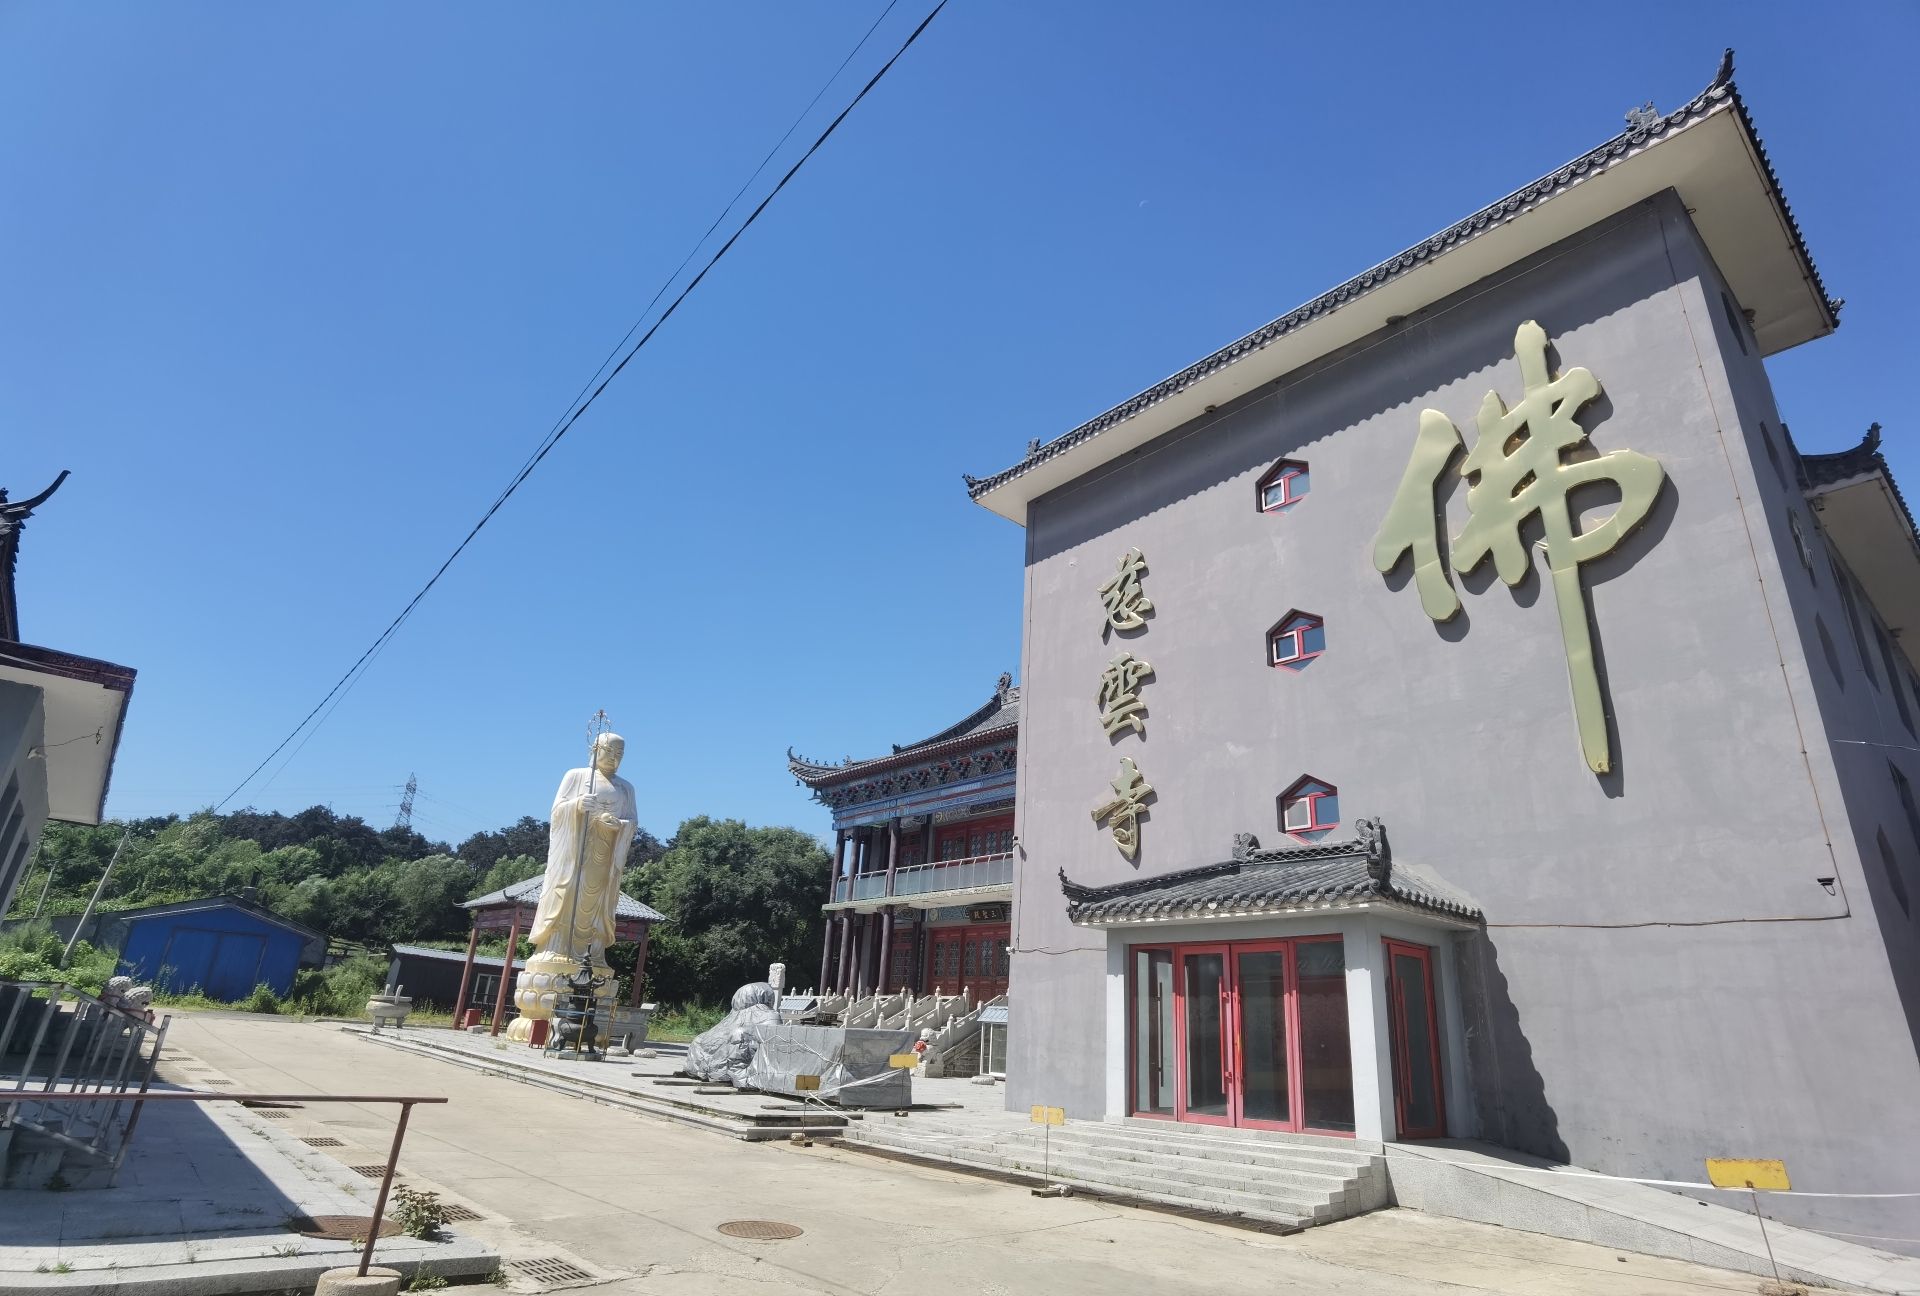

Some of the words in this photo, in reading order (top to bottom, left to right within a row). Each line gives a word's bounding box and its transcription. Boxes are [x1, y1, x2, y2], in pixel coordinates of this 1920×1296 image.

[1091, 547, 1153, 860] 慈雲寺
[1373, 320, 1666, 773] 佛
